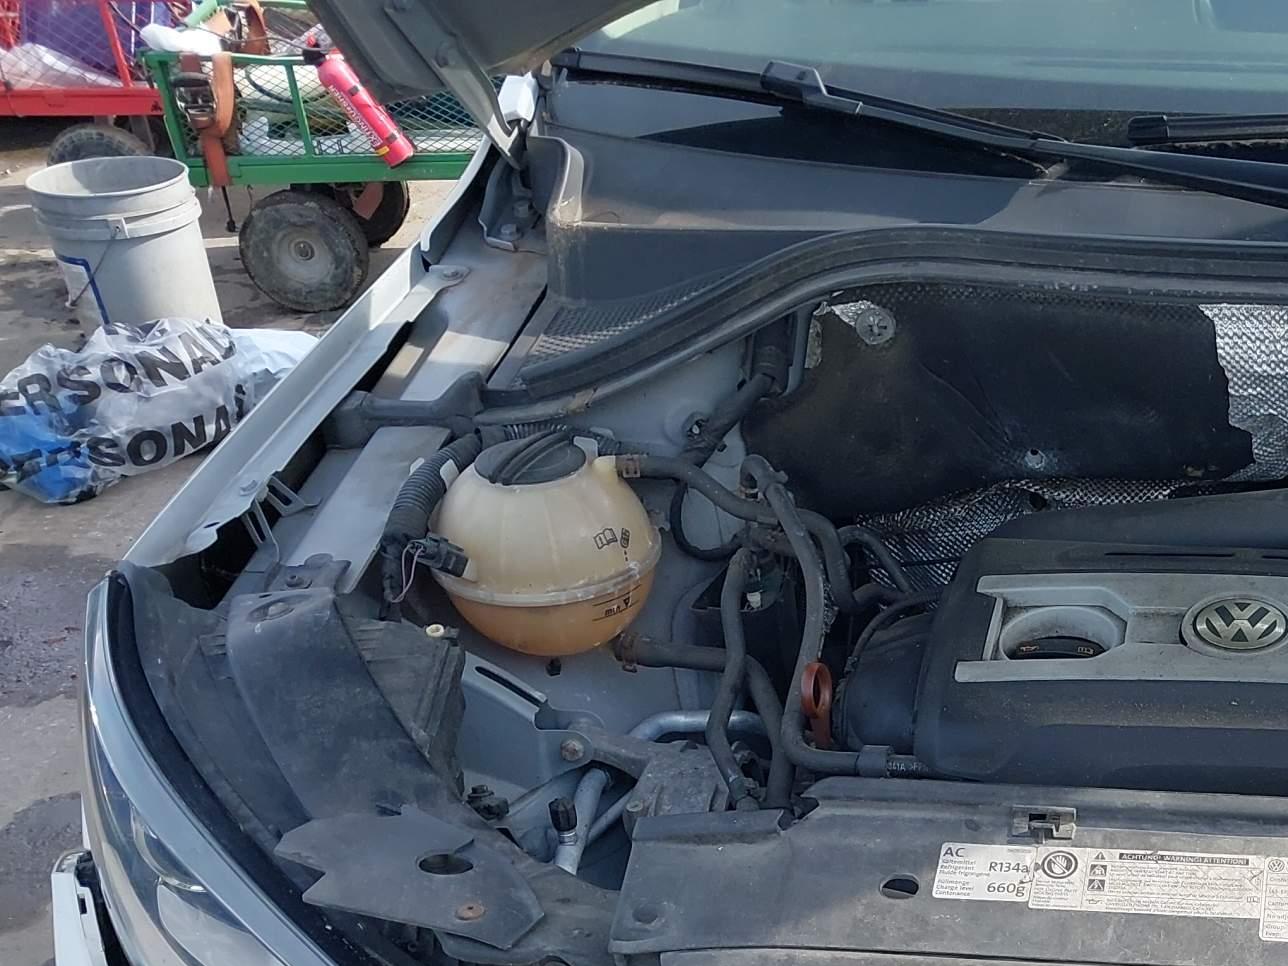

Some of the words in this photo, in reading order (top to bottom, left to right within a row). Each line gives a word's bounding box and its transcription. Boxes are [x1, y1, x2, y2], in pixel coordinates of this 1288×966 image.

[943, 847, 966, 857] AC
[989, 862, 1029, 873] R134a
[987, 882, 1025, 897] 660g
